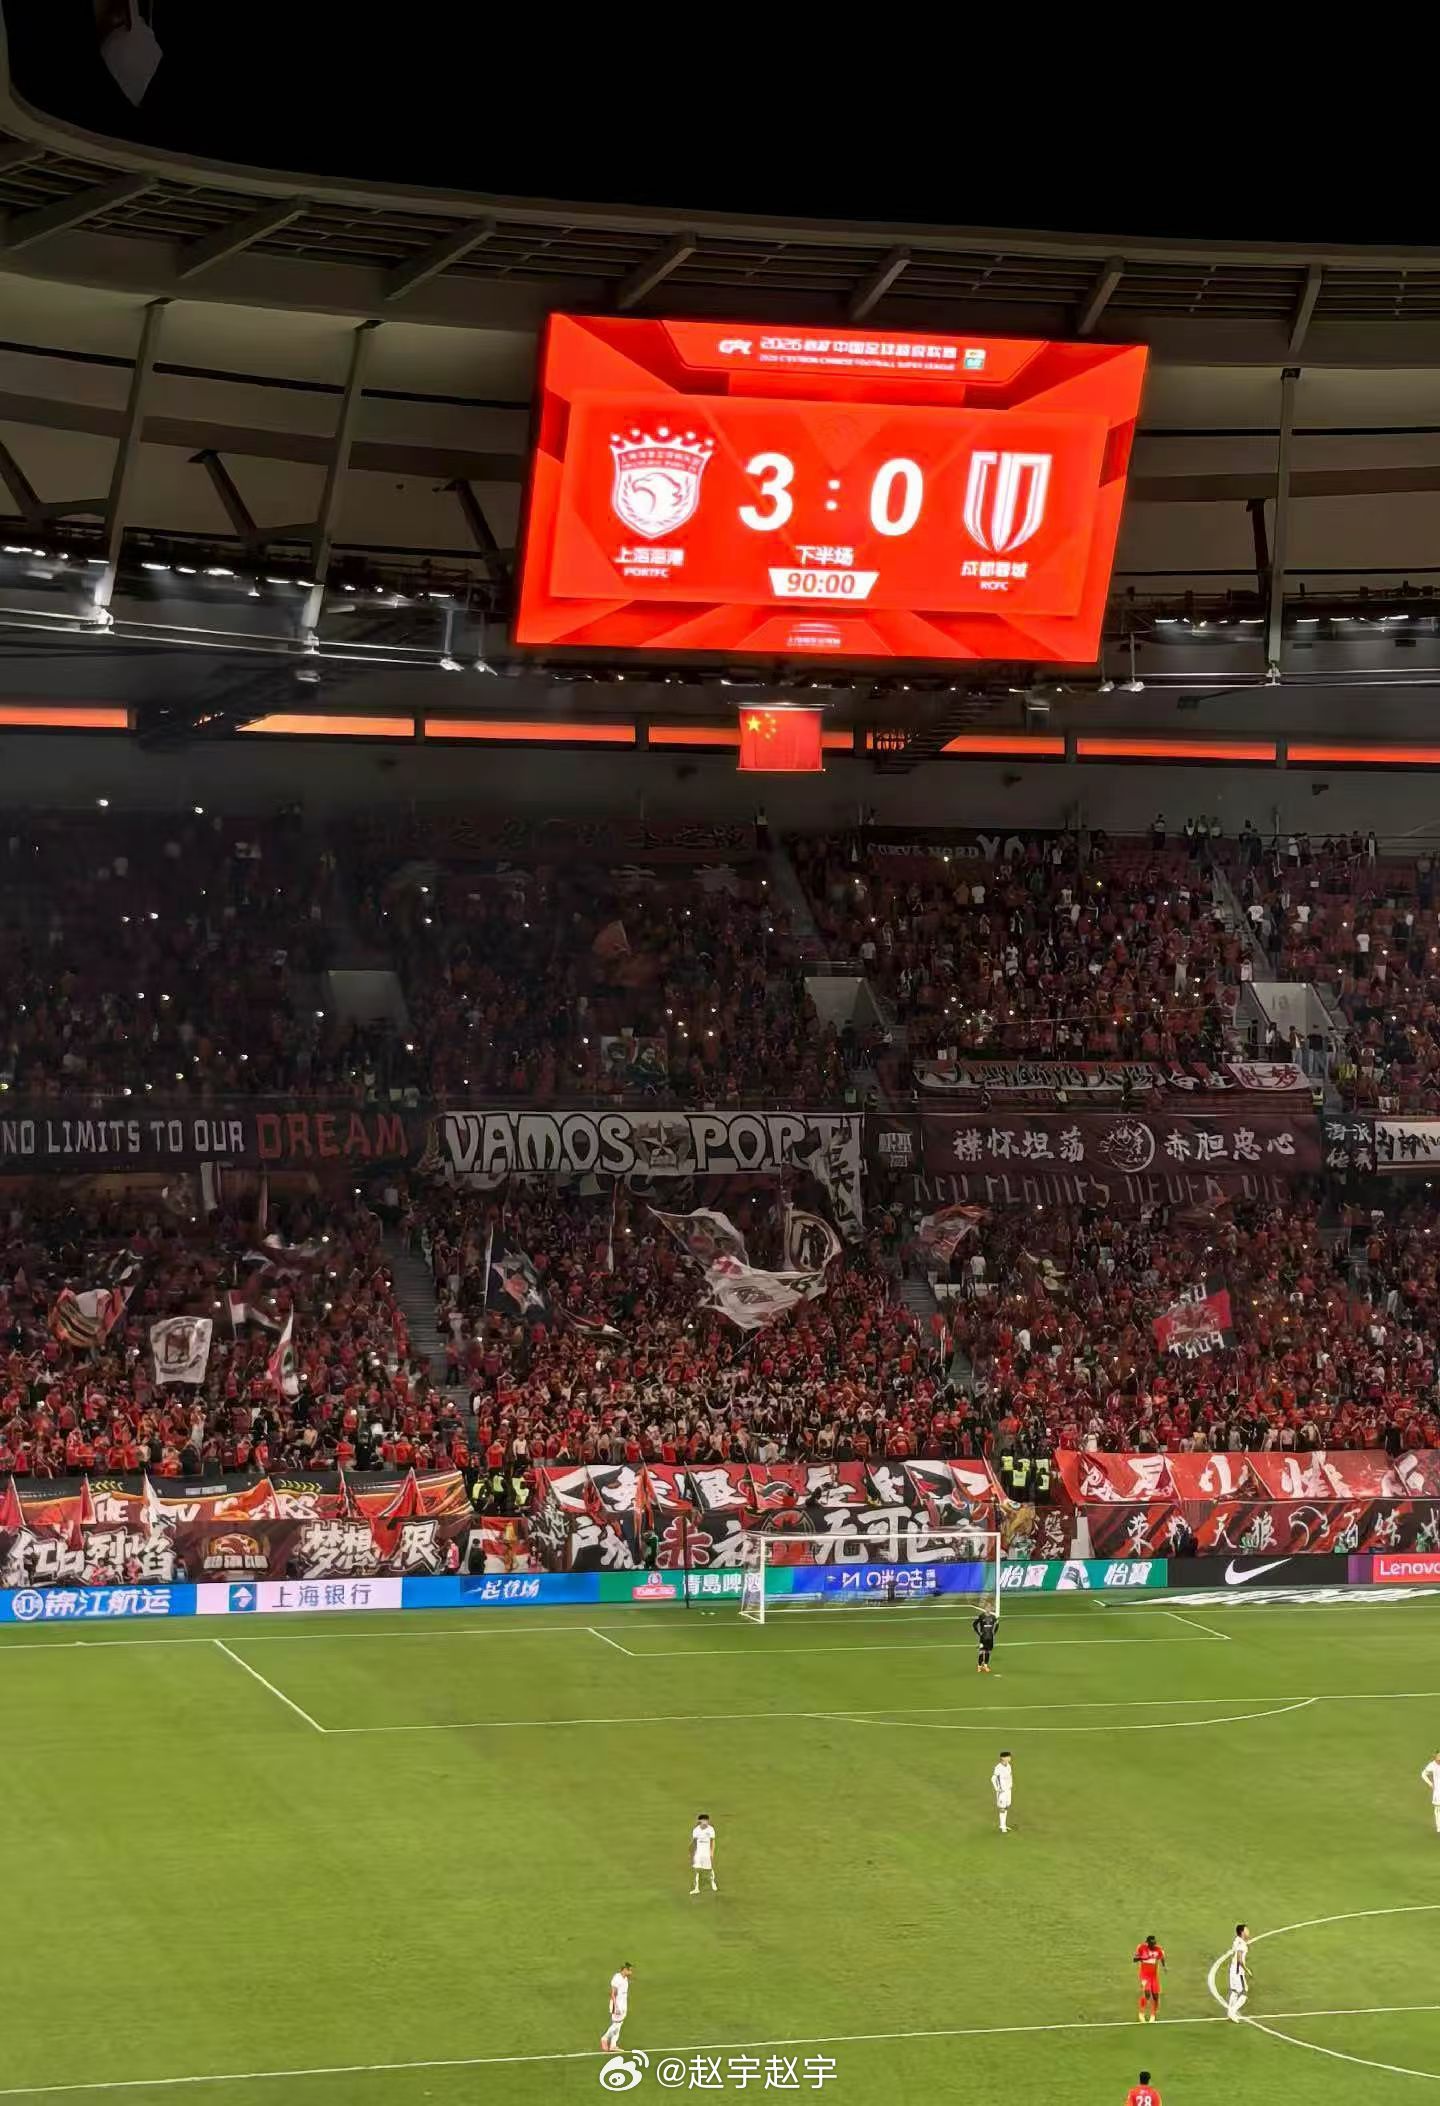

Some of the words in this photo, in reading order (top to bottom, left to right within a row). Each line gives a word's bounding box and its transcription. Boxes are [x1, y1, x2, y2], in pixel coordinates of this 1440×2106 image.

[738, 453, 796, 532] 3
[869, 458, 925, 536] 0
[795, 545, 856, 567] 下半场
[786, 573, 856, 594] 90:00
[46, 1118, 142, 1156] LIMITS
[150, 1119, 187, 1154] TO
[193, 1119, 246, 1154] OUR
[256, 1111, 409, 1161] DREAM
[445, 1114, 638, 1174] VAMOS
[952, 1125, 1086, 1164] 襟怀坦荡
[1164, 1126, 1297, 1163] 赤胆忠心
[300, 1519, 442, 1579] 梦想限
[45, 1589, 172, 1617] 锦江航运
[271, 1583, 372, 1609] 上海银行
